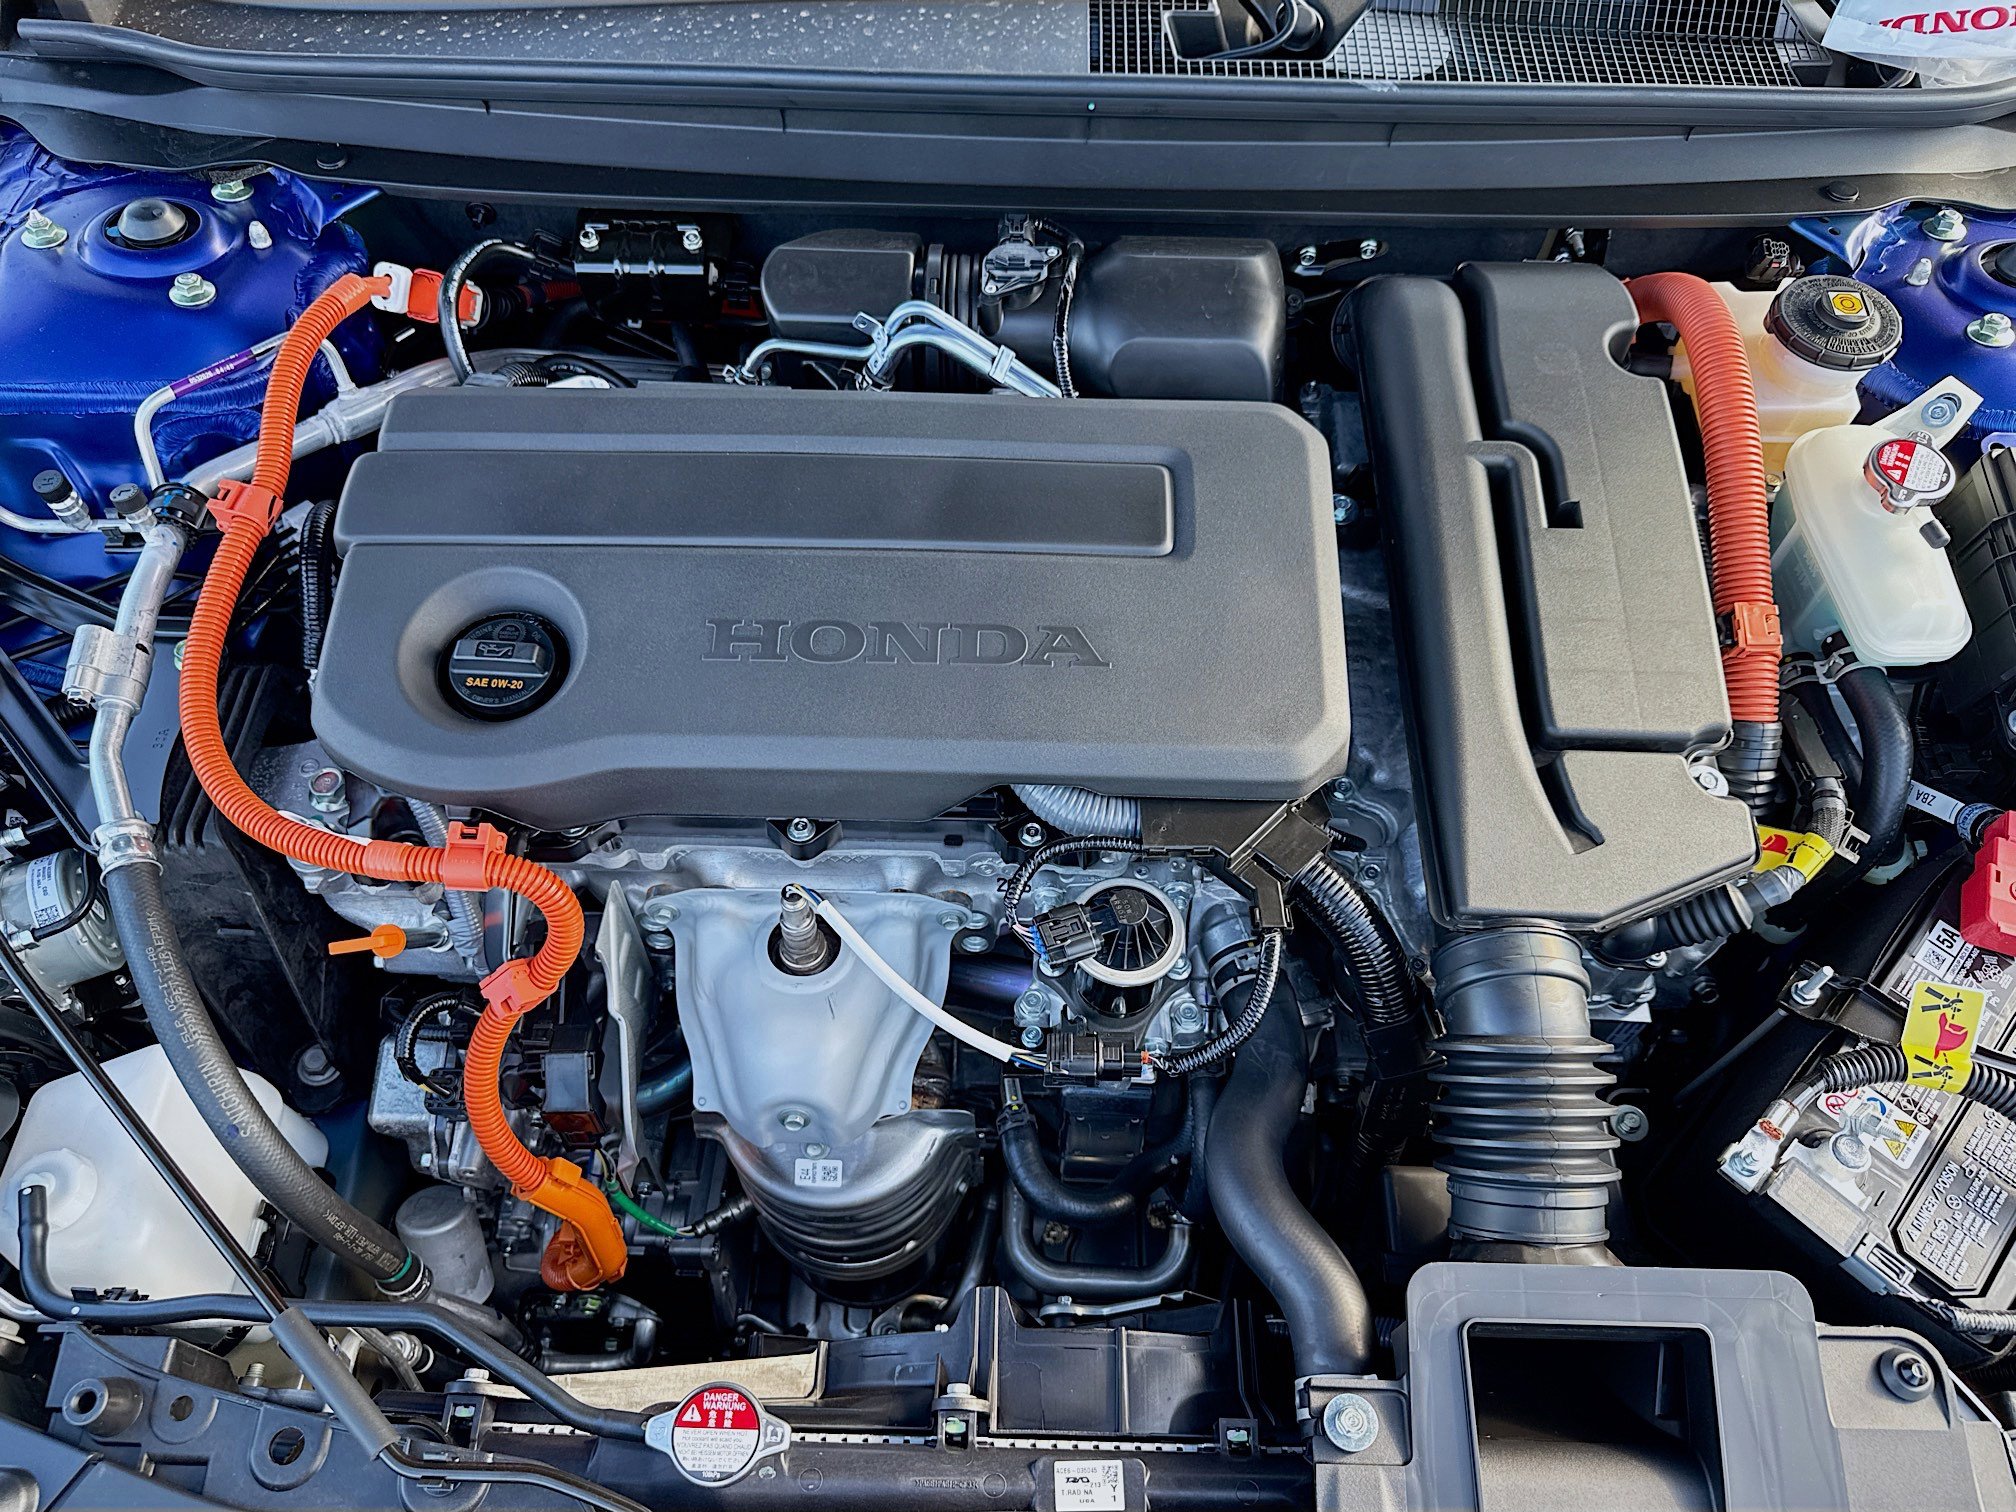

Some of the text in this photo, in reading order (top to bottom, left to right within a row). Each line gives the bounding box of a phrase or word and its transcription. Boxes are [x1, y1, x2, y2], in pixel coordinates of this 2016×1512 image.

[1879, 6, 2016, 34] OND
[701, 618, 1113, 669] HONDA
[466, 677, 523, 689] SAE 0W-20
[1915, 789, 1937, 806] ZBA
[1934, 924, 1961, 950] 5A
[703, 1401, 746, 1410] WARNUNG
[704, 1393, 739, 1402] DANGER
